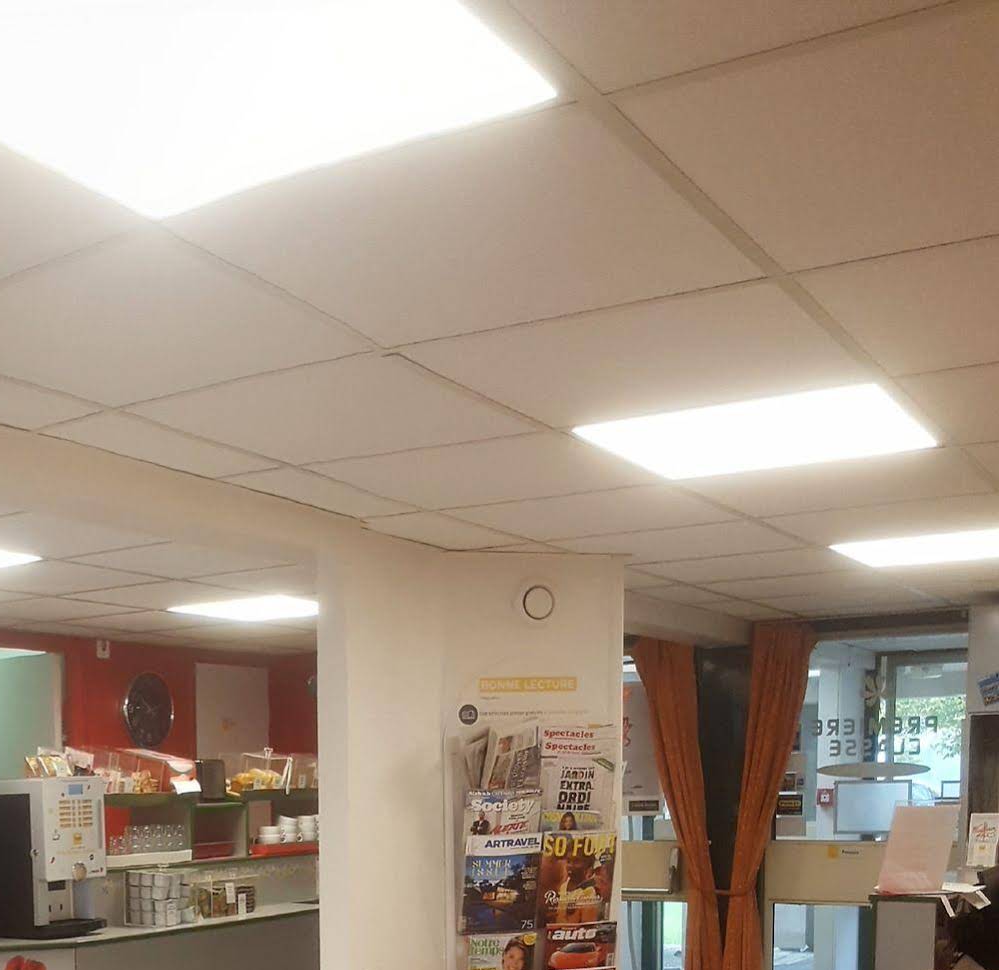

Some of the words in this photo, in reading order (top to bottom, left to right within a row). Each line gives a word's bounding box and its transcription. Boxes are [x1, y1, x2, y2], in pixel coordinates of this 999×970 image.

[480, 679, 519, 690] BONNE
[524, 678, 575, 690] LECTURE
[543, 730, 594, 739] Spectacles
[545, 742, 596, 751] Spectacles
[560, 770, 595, 780] JARDIN
[558, 791, 592, 804] ORDI
[470, 799, 535, 815] Society
[485, 836, 540, 849] ARTRAVEL
[543, 835, 567, 857] SO
[521, 919, 534, 930] 75
